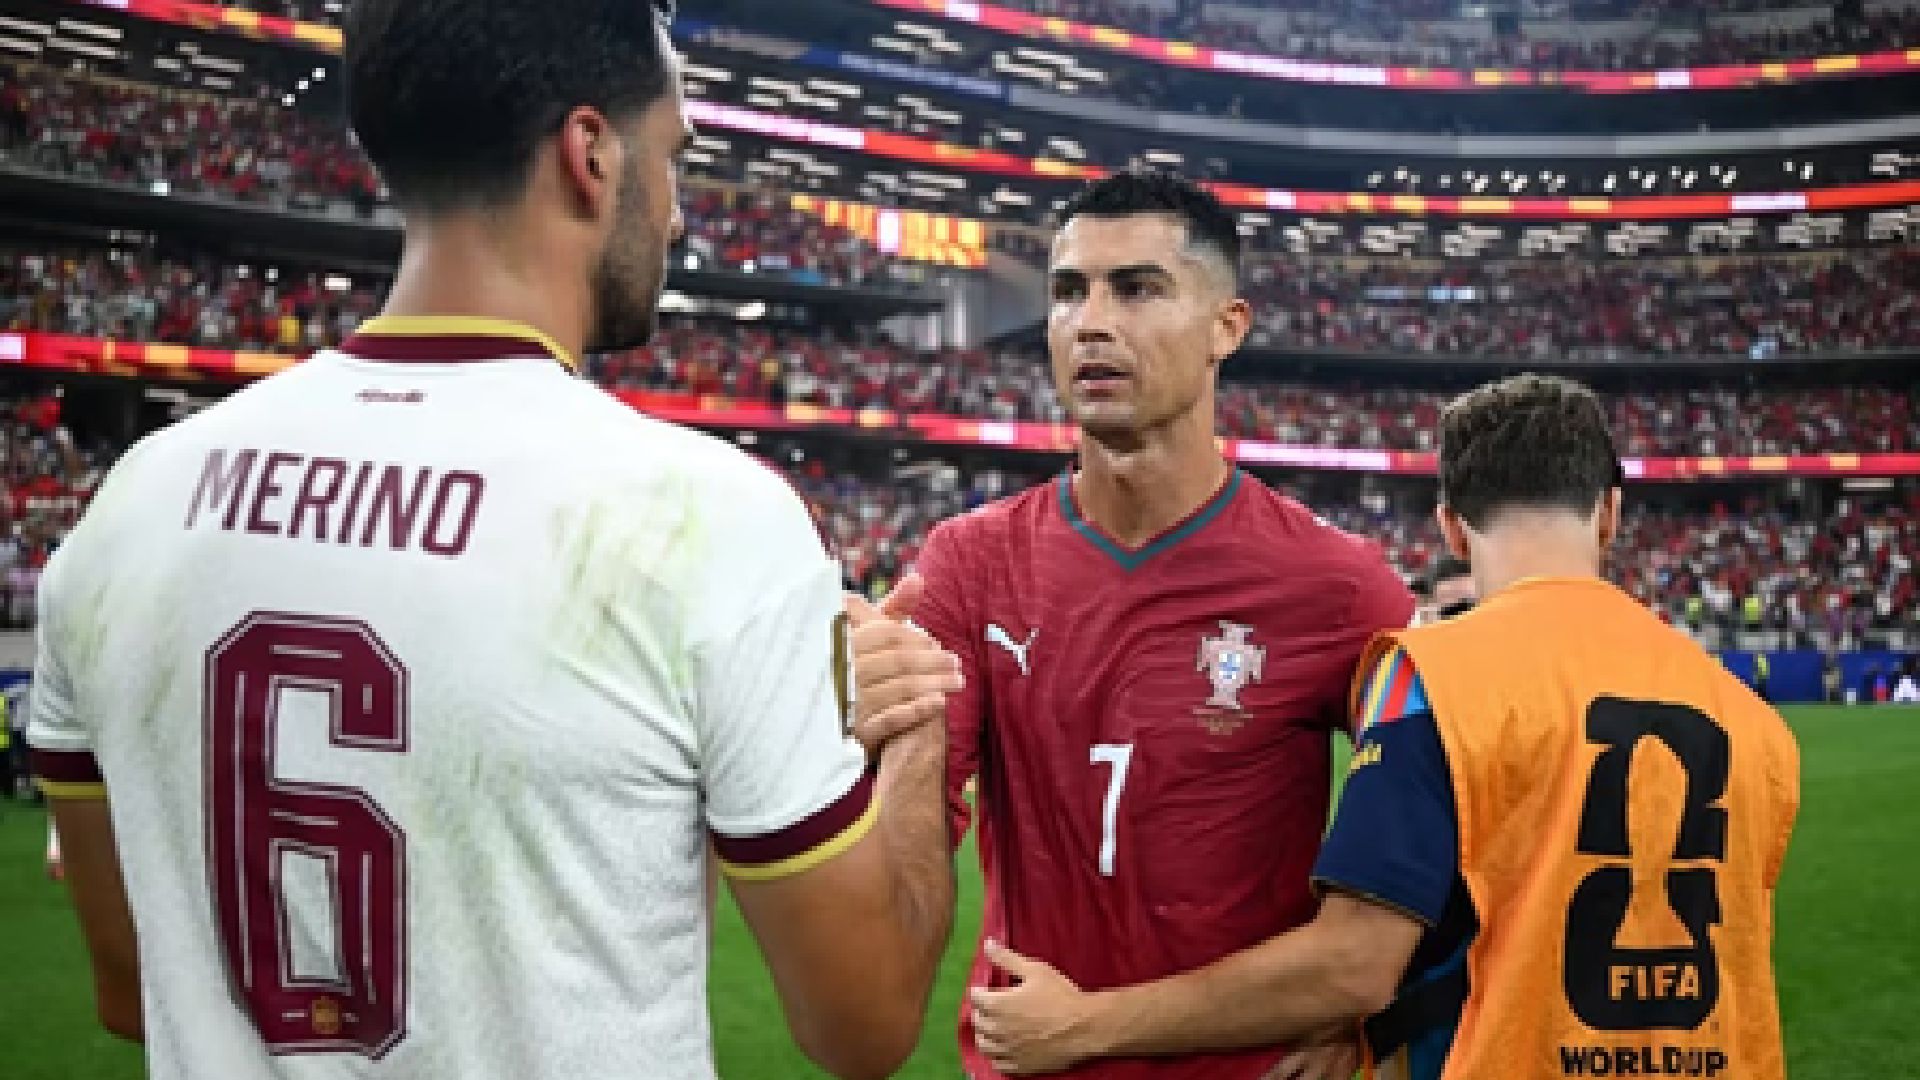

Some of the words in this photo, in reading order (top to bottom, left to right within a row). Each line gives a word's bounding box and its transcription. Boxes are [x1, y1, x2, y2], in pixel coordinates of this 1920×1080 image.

[185, 448, 486, 558] MERINO
[203, 611, 410, 1061] 6
[1090, 744, 1133, 876] 7
[1609, 965, 1701, 999] FIFA
